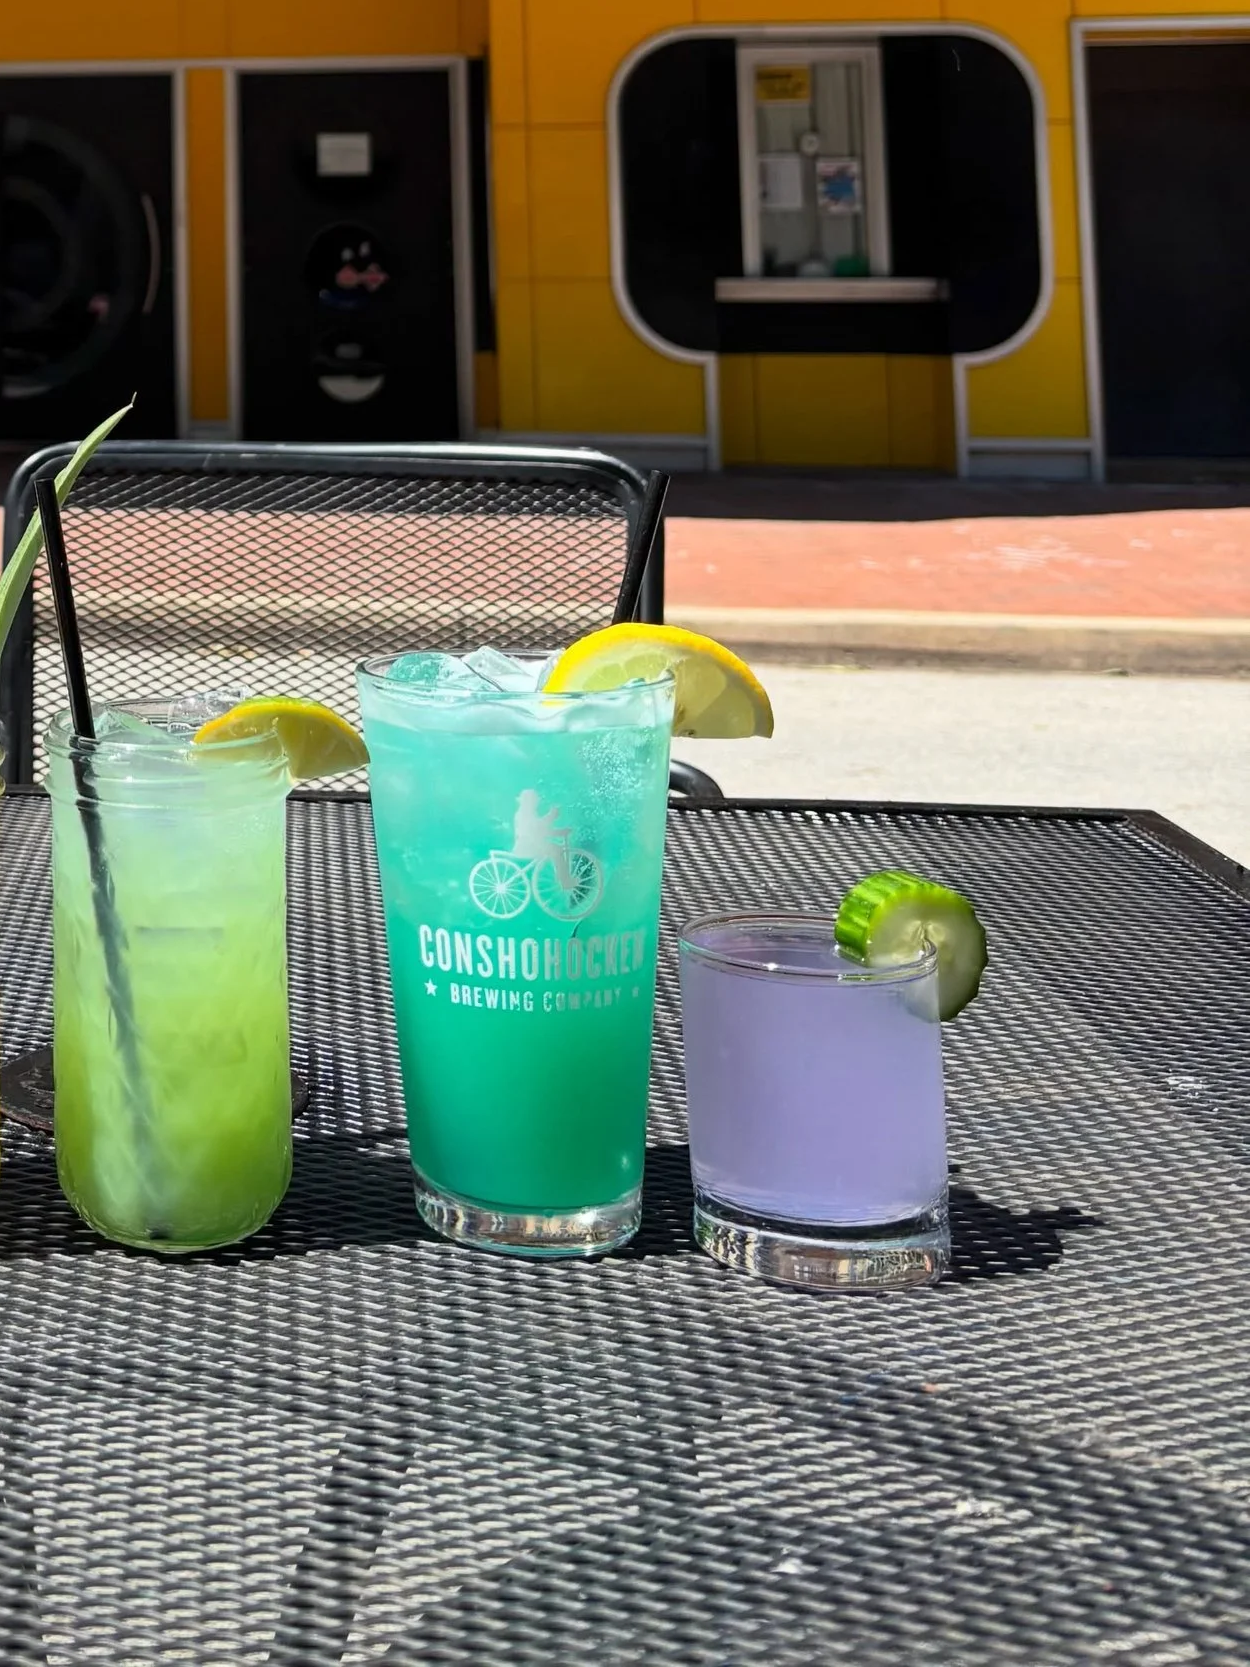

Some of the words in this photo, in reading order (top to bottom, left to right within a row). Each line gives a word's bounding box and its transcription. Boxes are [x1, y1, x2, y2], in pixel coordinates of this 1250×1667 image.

[419, 923, 647, 982] CONSHOHOCKEN
[450, 981, 535, 1013] BREWING
[542, 986, 622, 1013] COMPANY
